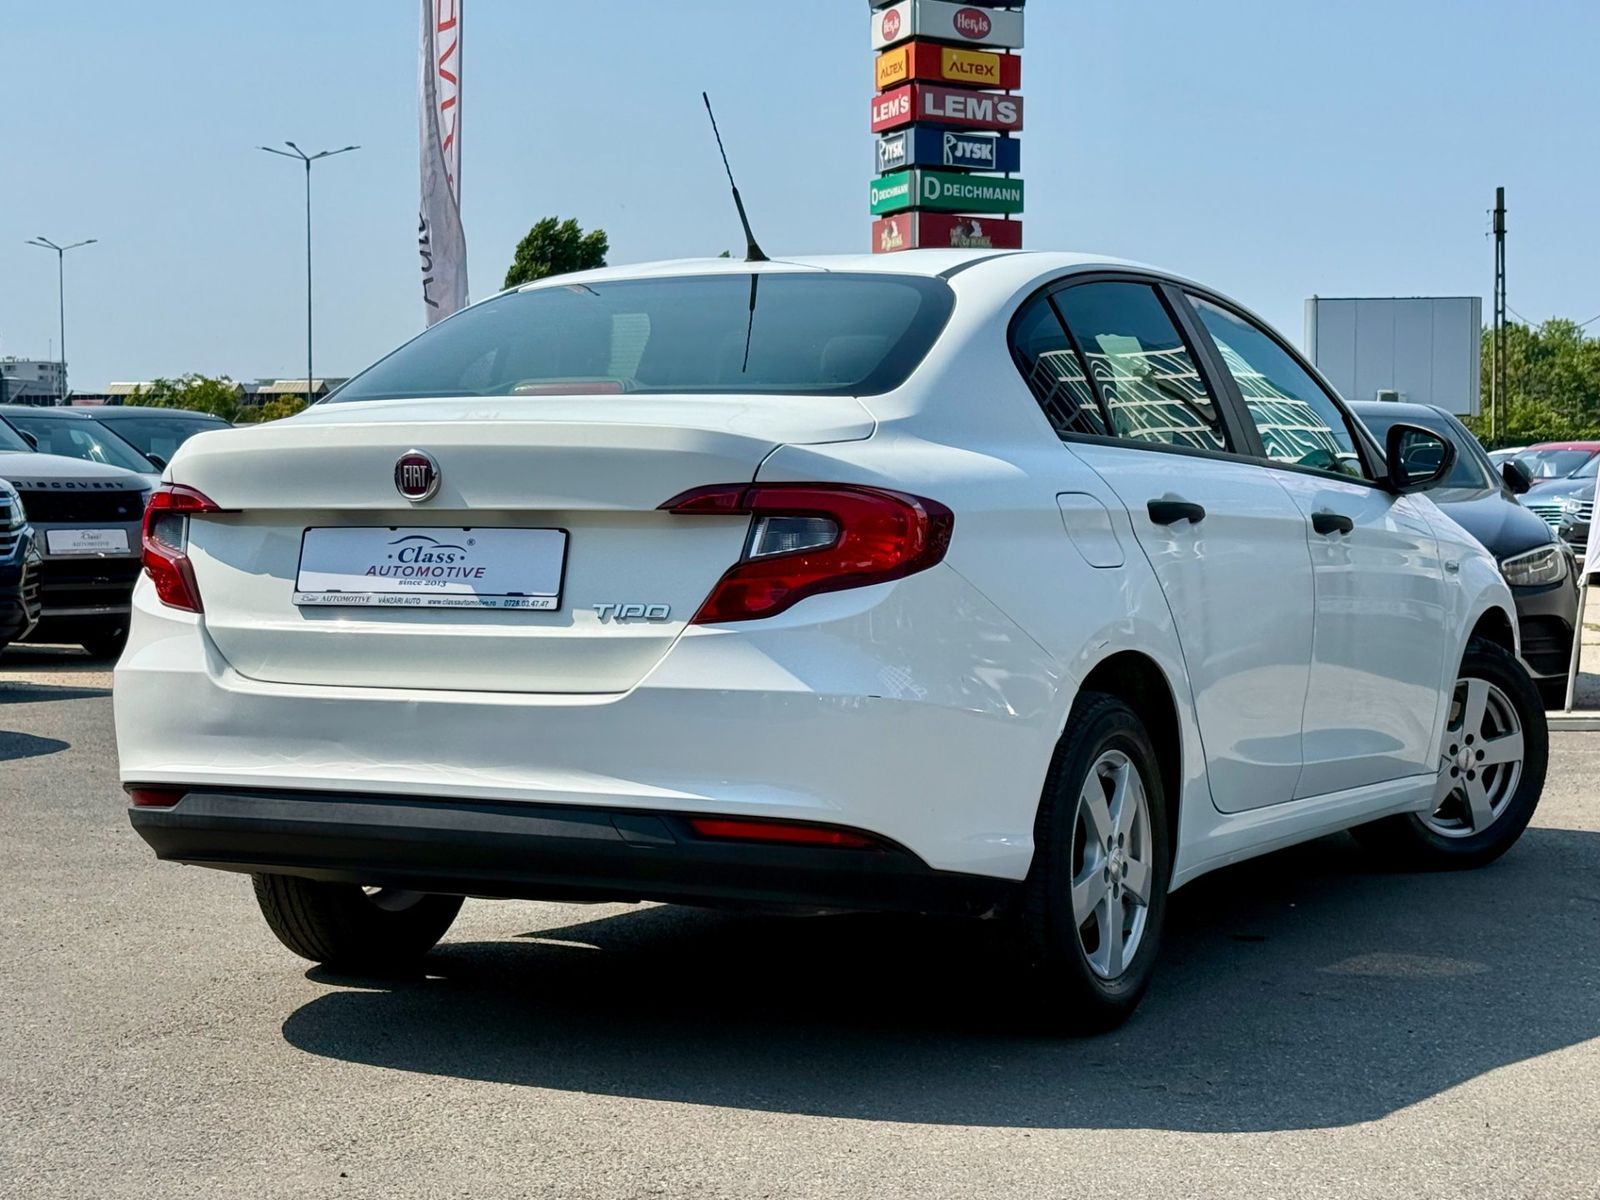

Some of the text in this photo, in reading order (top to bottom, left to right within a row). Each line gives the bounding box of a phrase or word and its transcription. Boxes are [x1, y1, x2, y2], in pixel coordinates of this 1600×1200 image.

[957, 14, 988, 32] Hervis
[873, 96, 910, 123] LEM'S
[925, 92, 1017, 124] LEM'S
[884, 140, 903, 160] JYSK
[954, 142, 992, 160] JYSK
[944, 183, 1020, 202] DEICHMANN
[403, 465, 427, 488] FIAT
[397, 546, 455, 564] Class
[365, 565, 486, 579] AUTOMOTIVE
[424, 579, 447, 588] 2013
[404, 597, 421, 605] AUTO
[592, 603, 671, 620] TIPO
